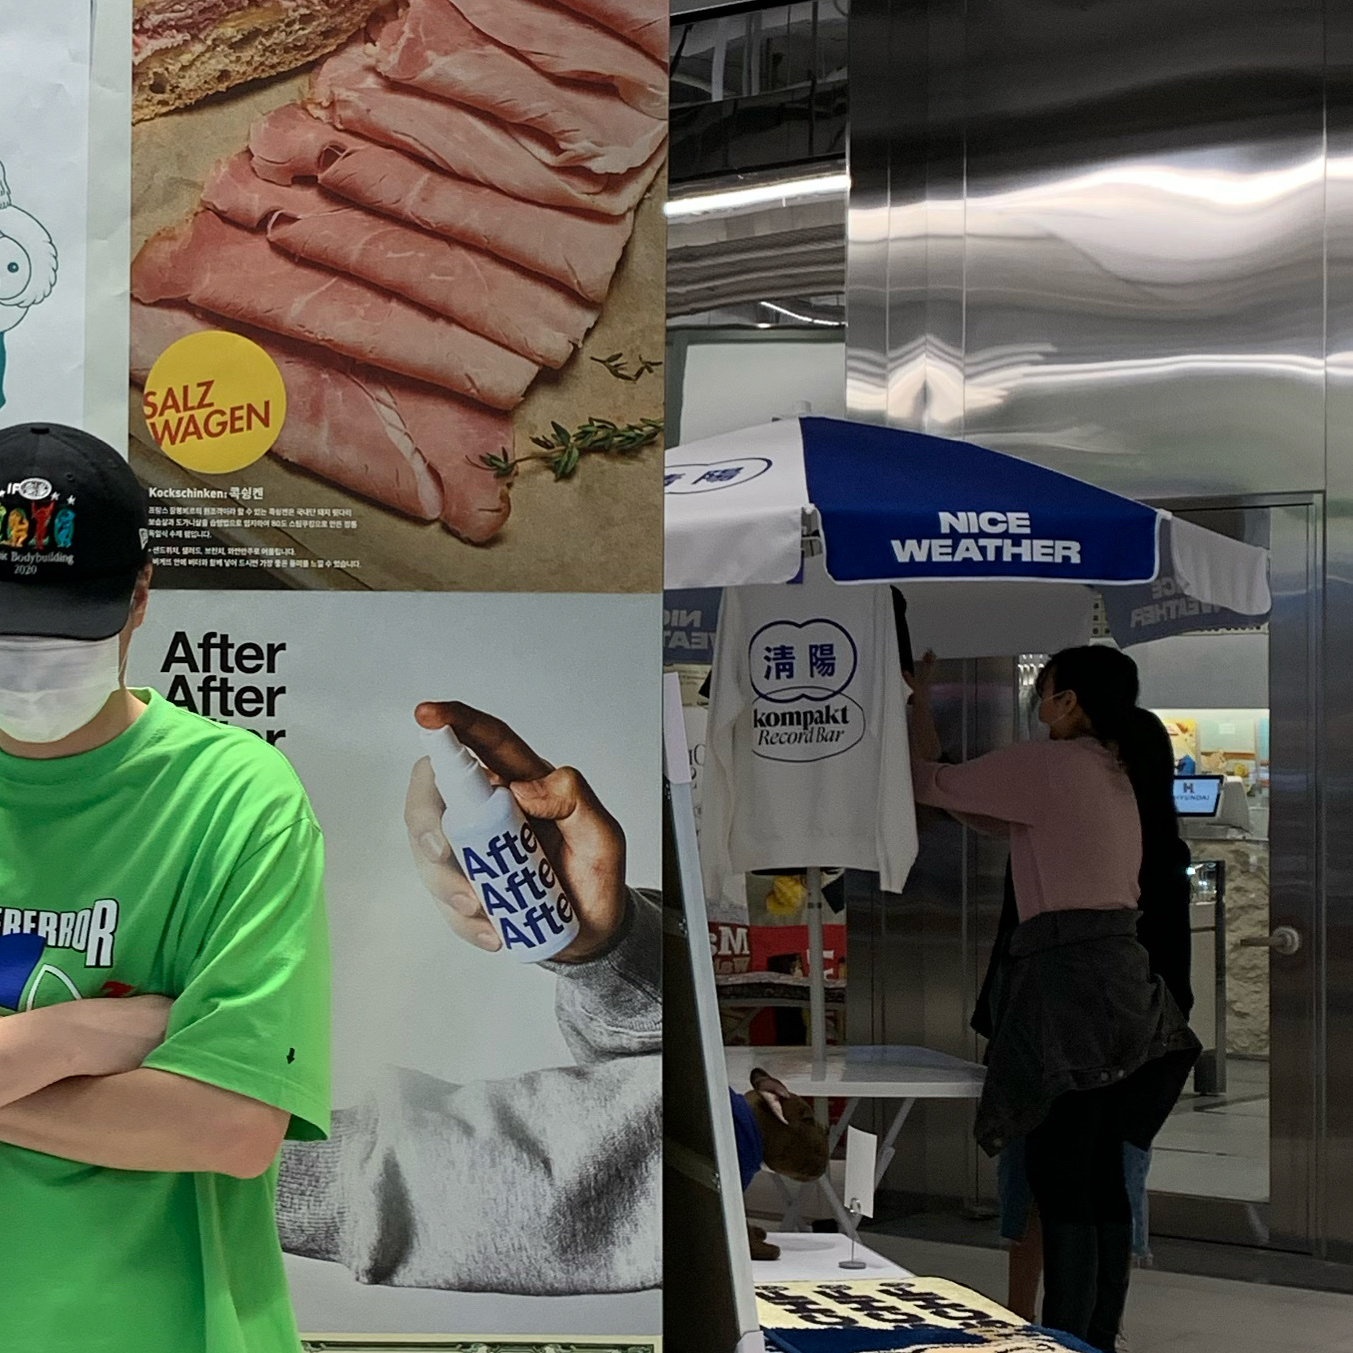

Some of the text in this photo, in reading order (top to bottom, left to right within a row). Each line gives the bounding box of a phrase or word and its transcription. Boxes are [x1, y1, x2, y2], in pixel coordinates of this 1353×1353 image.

[145, 379, 215, 420] SALZ
[150, 400, 271, 447] WAGEN
[149, 488, 228, 499] Kockschinken:
[938, 510, 1031, 534] NICE
[11, 551, 74, 565] Bodybuilding
[890, 538, 1081, 564] WEATHER
[14, 564, 37, 574] 2020
[160, 630, 286, 674] After
[165, 675, 286, 718] After
[753, 704, 850, 731] kompakt
[758, 726, 846, 745] Record Bar
